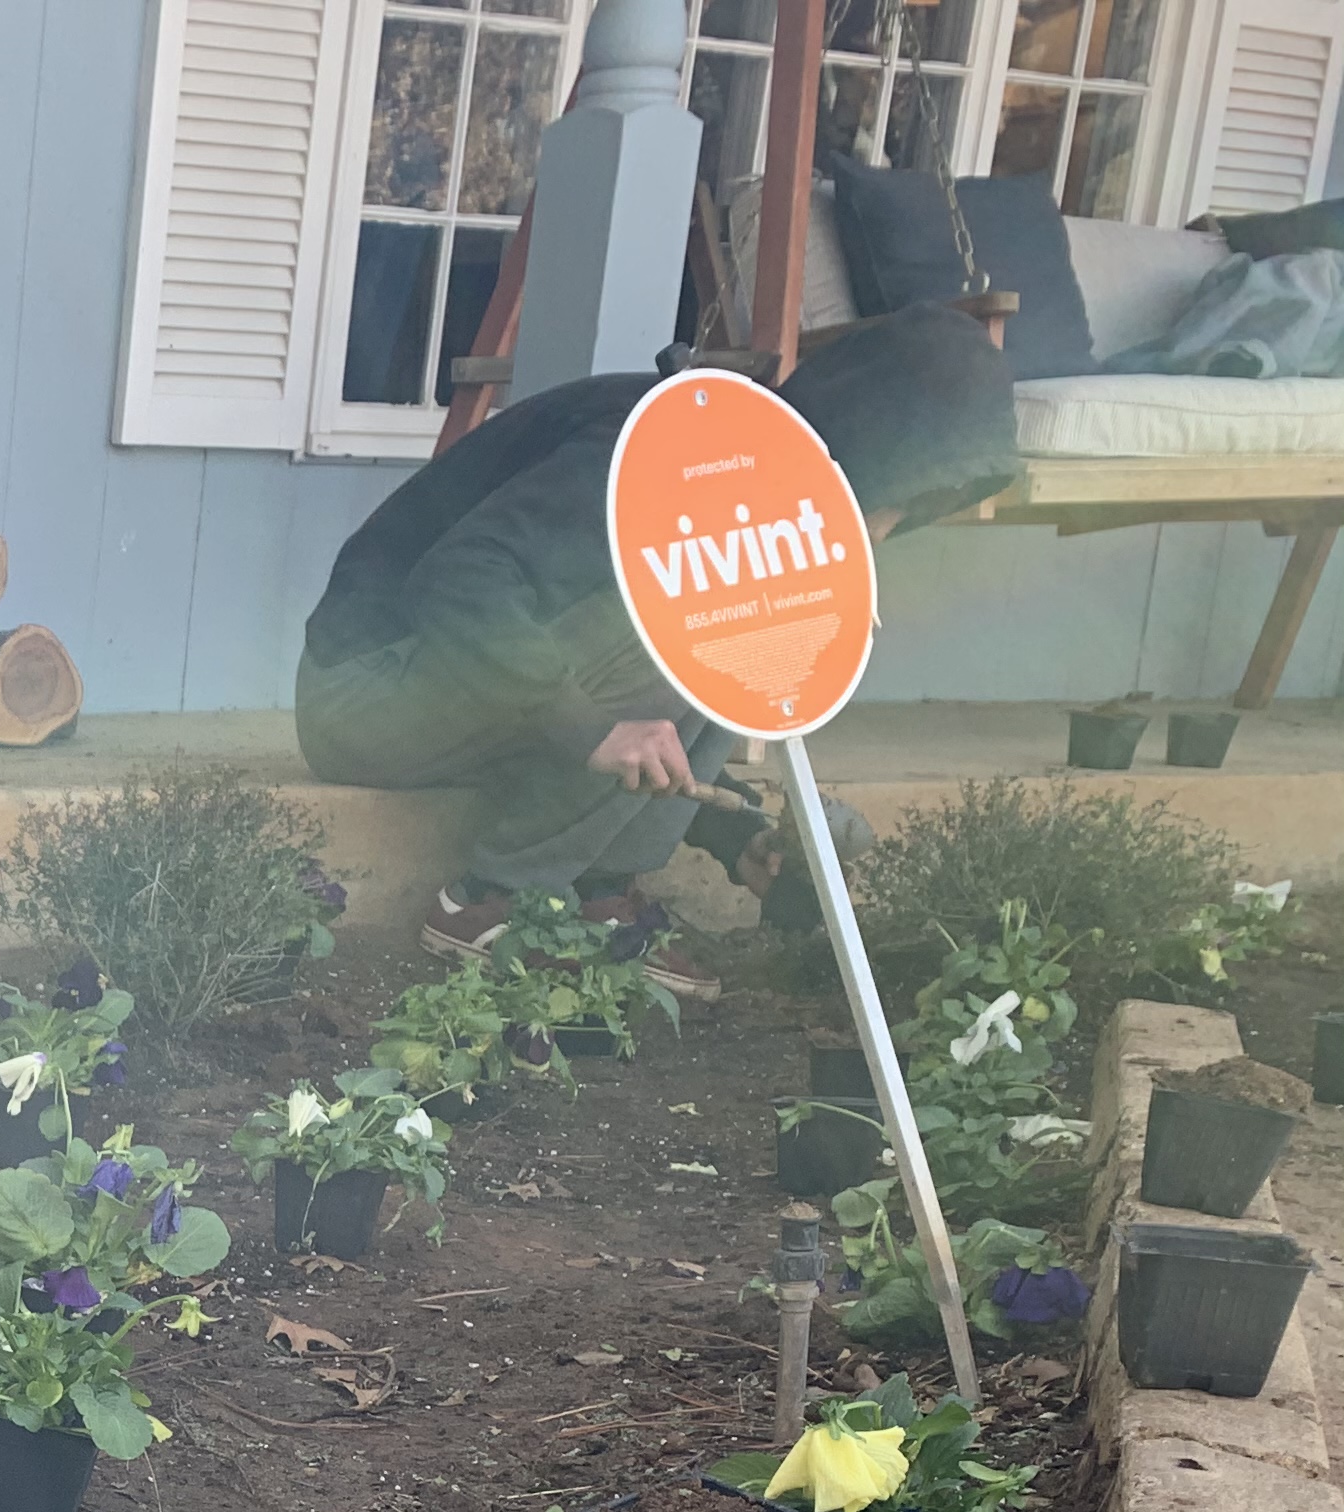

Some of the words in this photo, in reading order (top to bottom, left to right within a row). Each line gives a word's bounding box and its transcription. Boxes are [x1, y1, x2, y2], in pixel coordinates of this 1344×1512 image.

[683, 455, 740, 481] protected
[740, 453, 756, 470] by
[641, 498, 846, 598] vivint.
[685, 600, 760, 630] 855.4VIVINT
[772, 588, 833, 610] vivint.com
